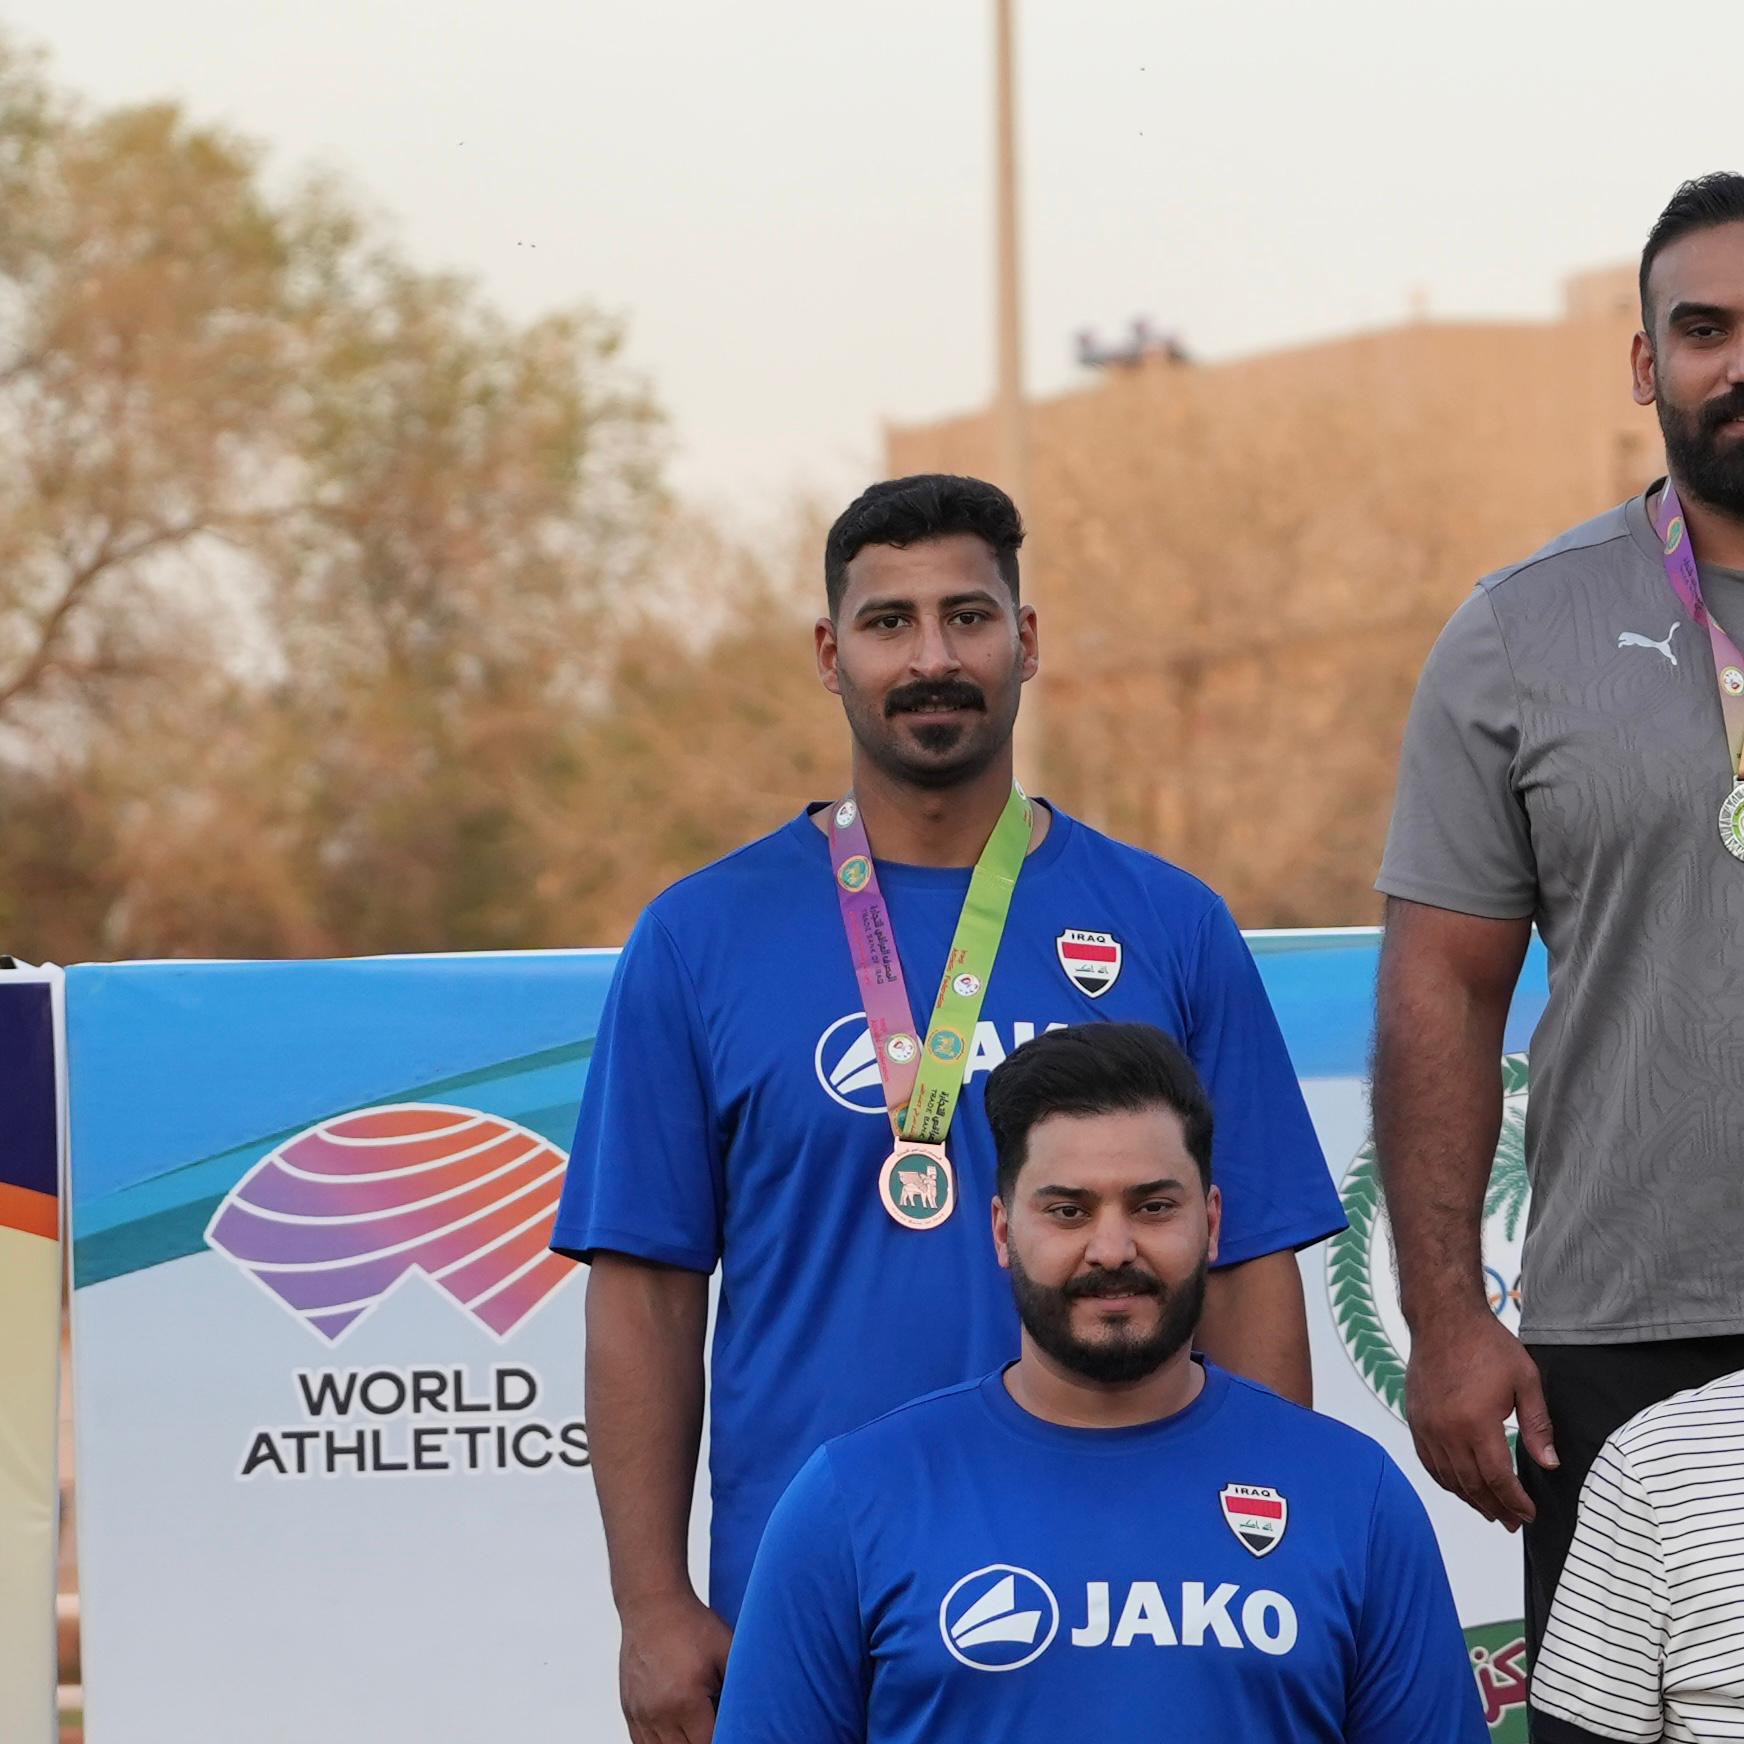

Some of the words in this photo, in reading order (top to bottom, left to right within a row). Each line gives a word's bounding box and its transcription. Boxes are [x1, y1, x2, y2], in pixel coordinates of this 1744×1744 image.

[1072, 933, 1105, 943] IRAQ
[924, 1087, 938, 1114] TRADE
[918, 1115, 931, 1139] BANK
[298, 1366, 537, 1417] WORLD
[241, 1422, 590, 1476] ATHLETICS
[1235, 1488, 1271, 1497] IRAQ
[1072, 1581, 1298, 1655] JAKO
